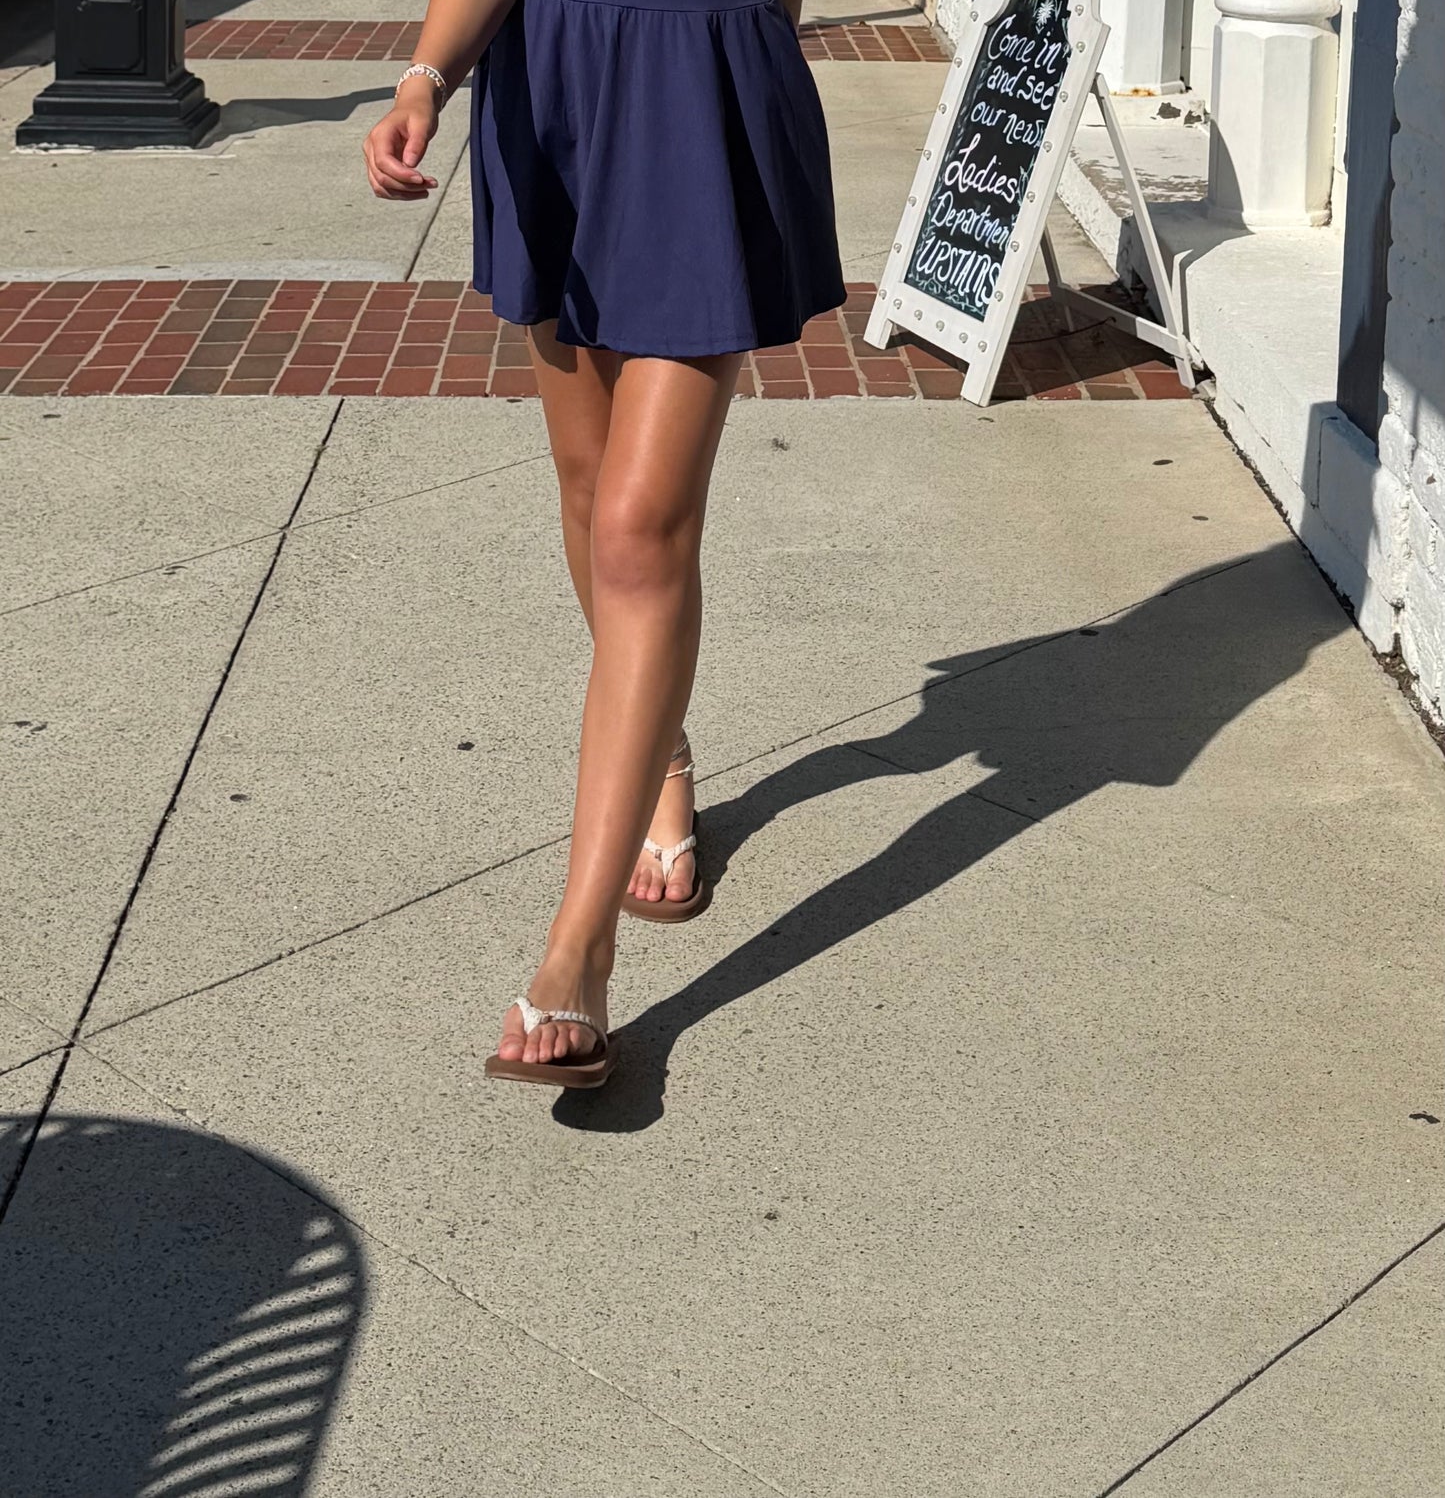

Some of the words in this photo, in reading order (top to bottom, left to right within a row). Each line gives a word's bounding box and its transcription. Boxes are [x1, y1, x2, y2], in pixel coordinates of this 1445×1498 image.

[988, 13, 1036, 63] Come
[1034, 31, 1062, 74] in
[986, 65, 1028, 97] and
[1016, 75, 1055, 111] see
[970, 101, 1007, 127] our
[1003, 113, 1045, 145] new
[944, 132, 1018, 204] Ladies
[916, 235, 1002, 307] UPSTAIRS
